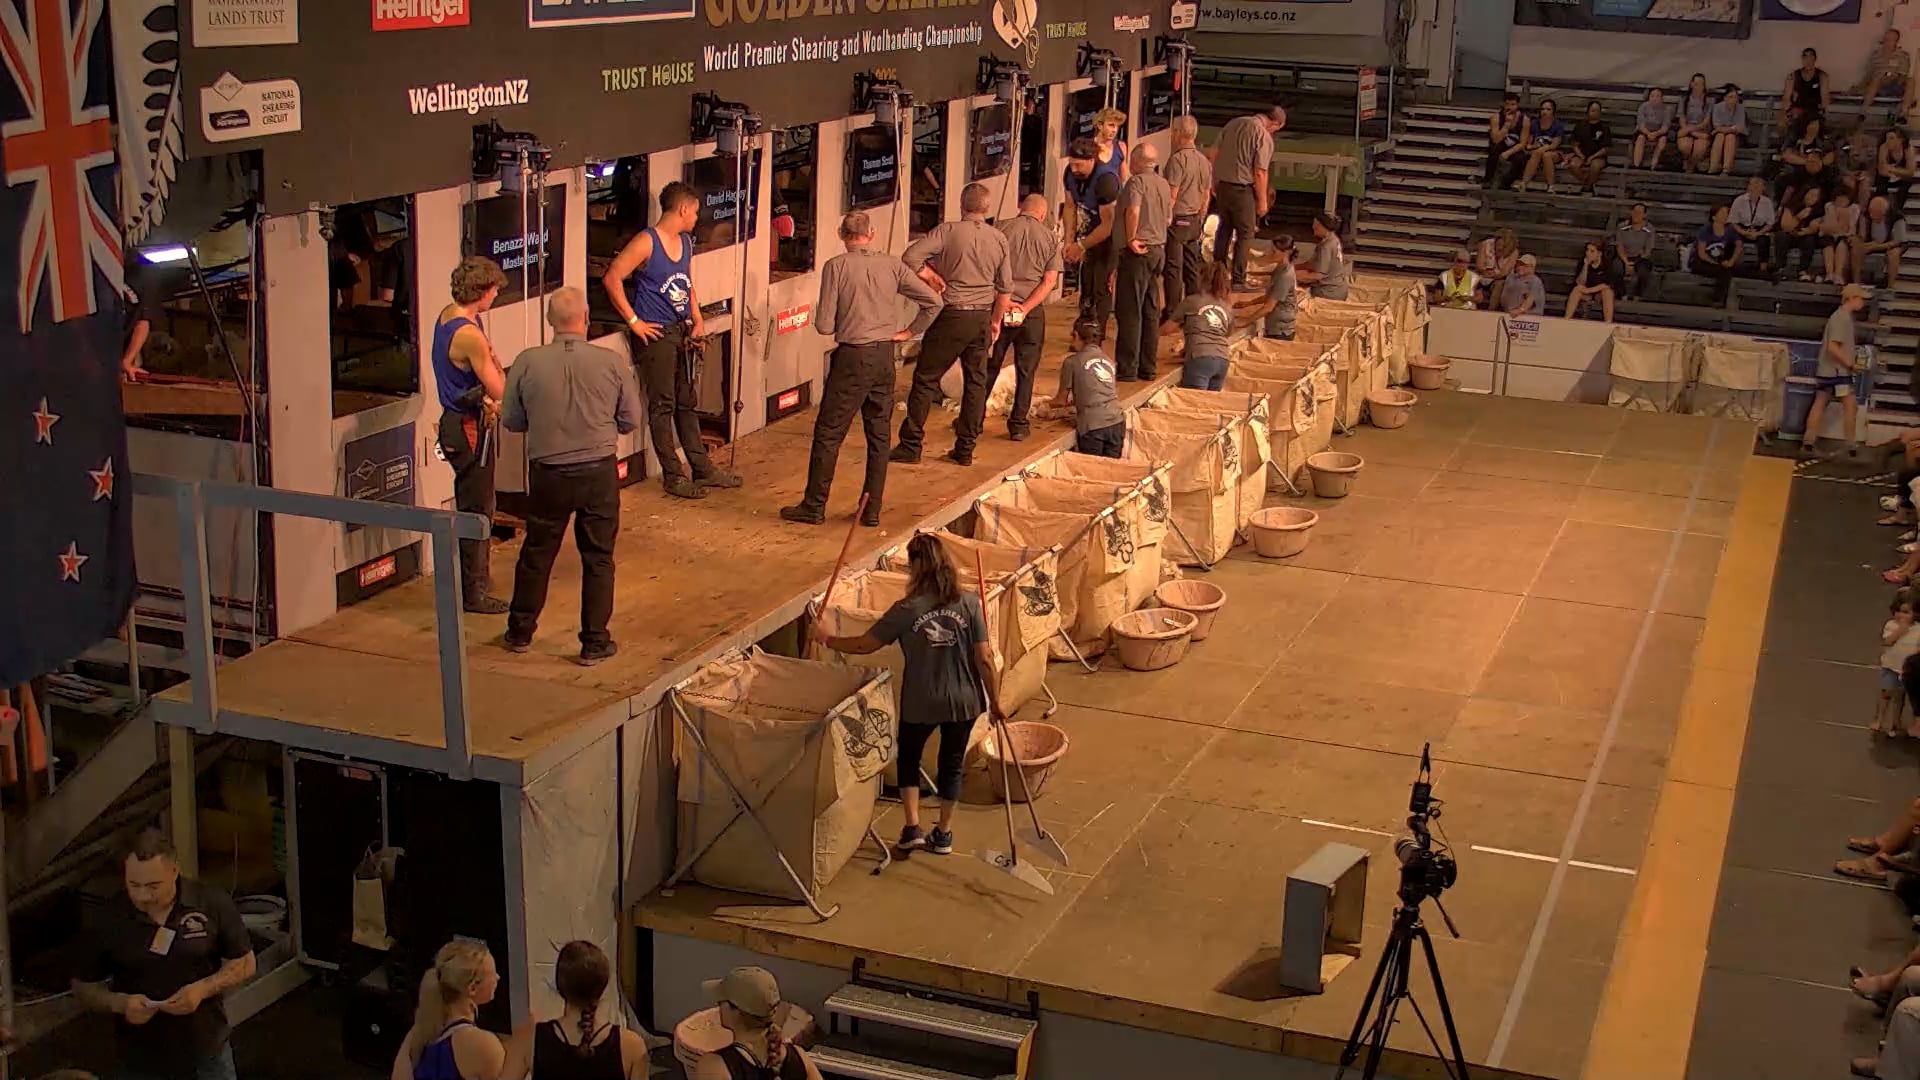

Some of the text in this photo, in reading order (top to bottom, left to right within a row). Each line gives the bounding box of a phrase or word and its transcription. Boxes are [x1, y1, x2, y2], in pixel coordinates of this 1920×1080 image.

[209, 9, 286, 26] LANDS TRUST
[1046, 23, 1066, 39] TRUST
[704, 20, 983, 72] World Premier Shearing and Woolhandling Championship
[602, 66, 647, 92] TRUST
[261, 89, 295, 102] NATIONAL
[408, 79, 530, 115] WellingtonNZ
[493, 228, 549, 255] Benazz Wad
[502, 254, 539, 271] Masteton
[912, 610, 939, 633] GOLDEN
